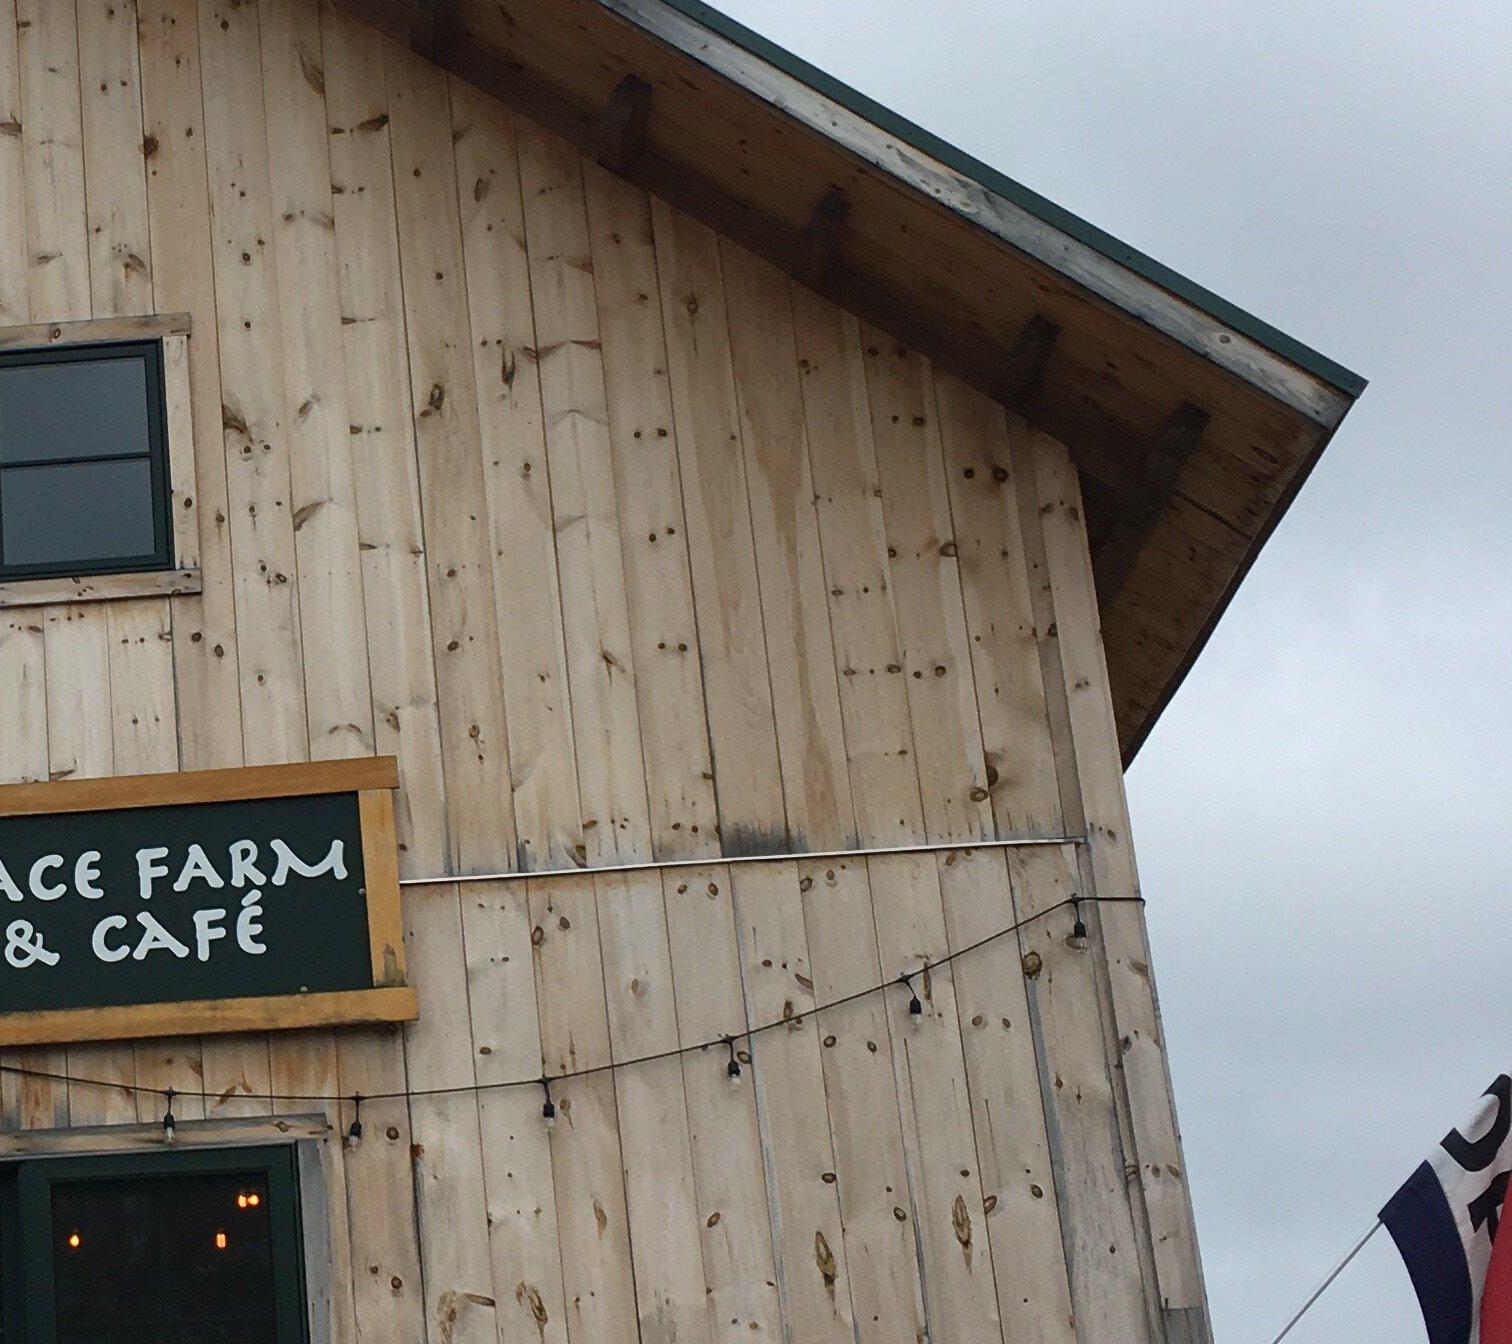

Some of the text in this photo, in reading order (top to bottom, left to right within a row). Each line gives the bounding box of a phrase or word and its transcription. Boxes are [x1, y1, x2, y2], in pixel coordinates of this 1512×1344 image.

[135, 838, 348, 900] FARM
[4, 919, 61, 968] &
[91, 888, 267, 962] CAFÉ
